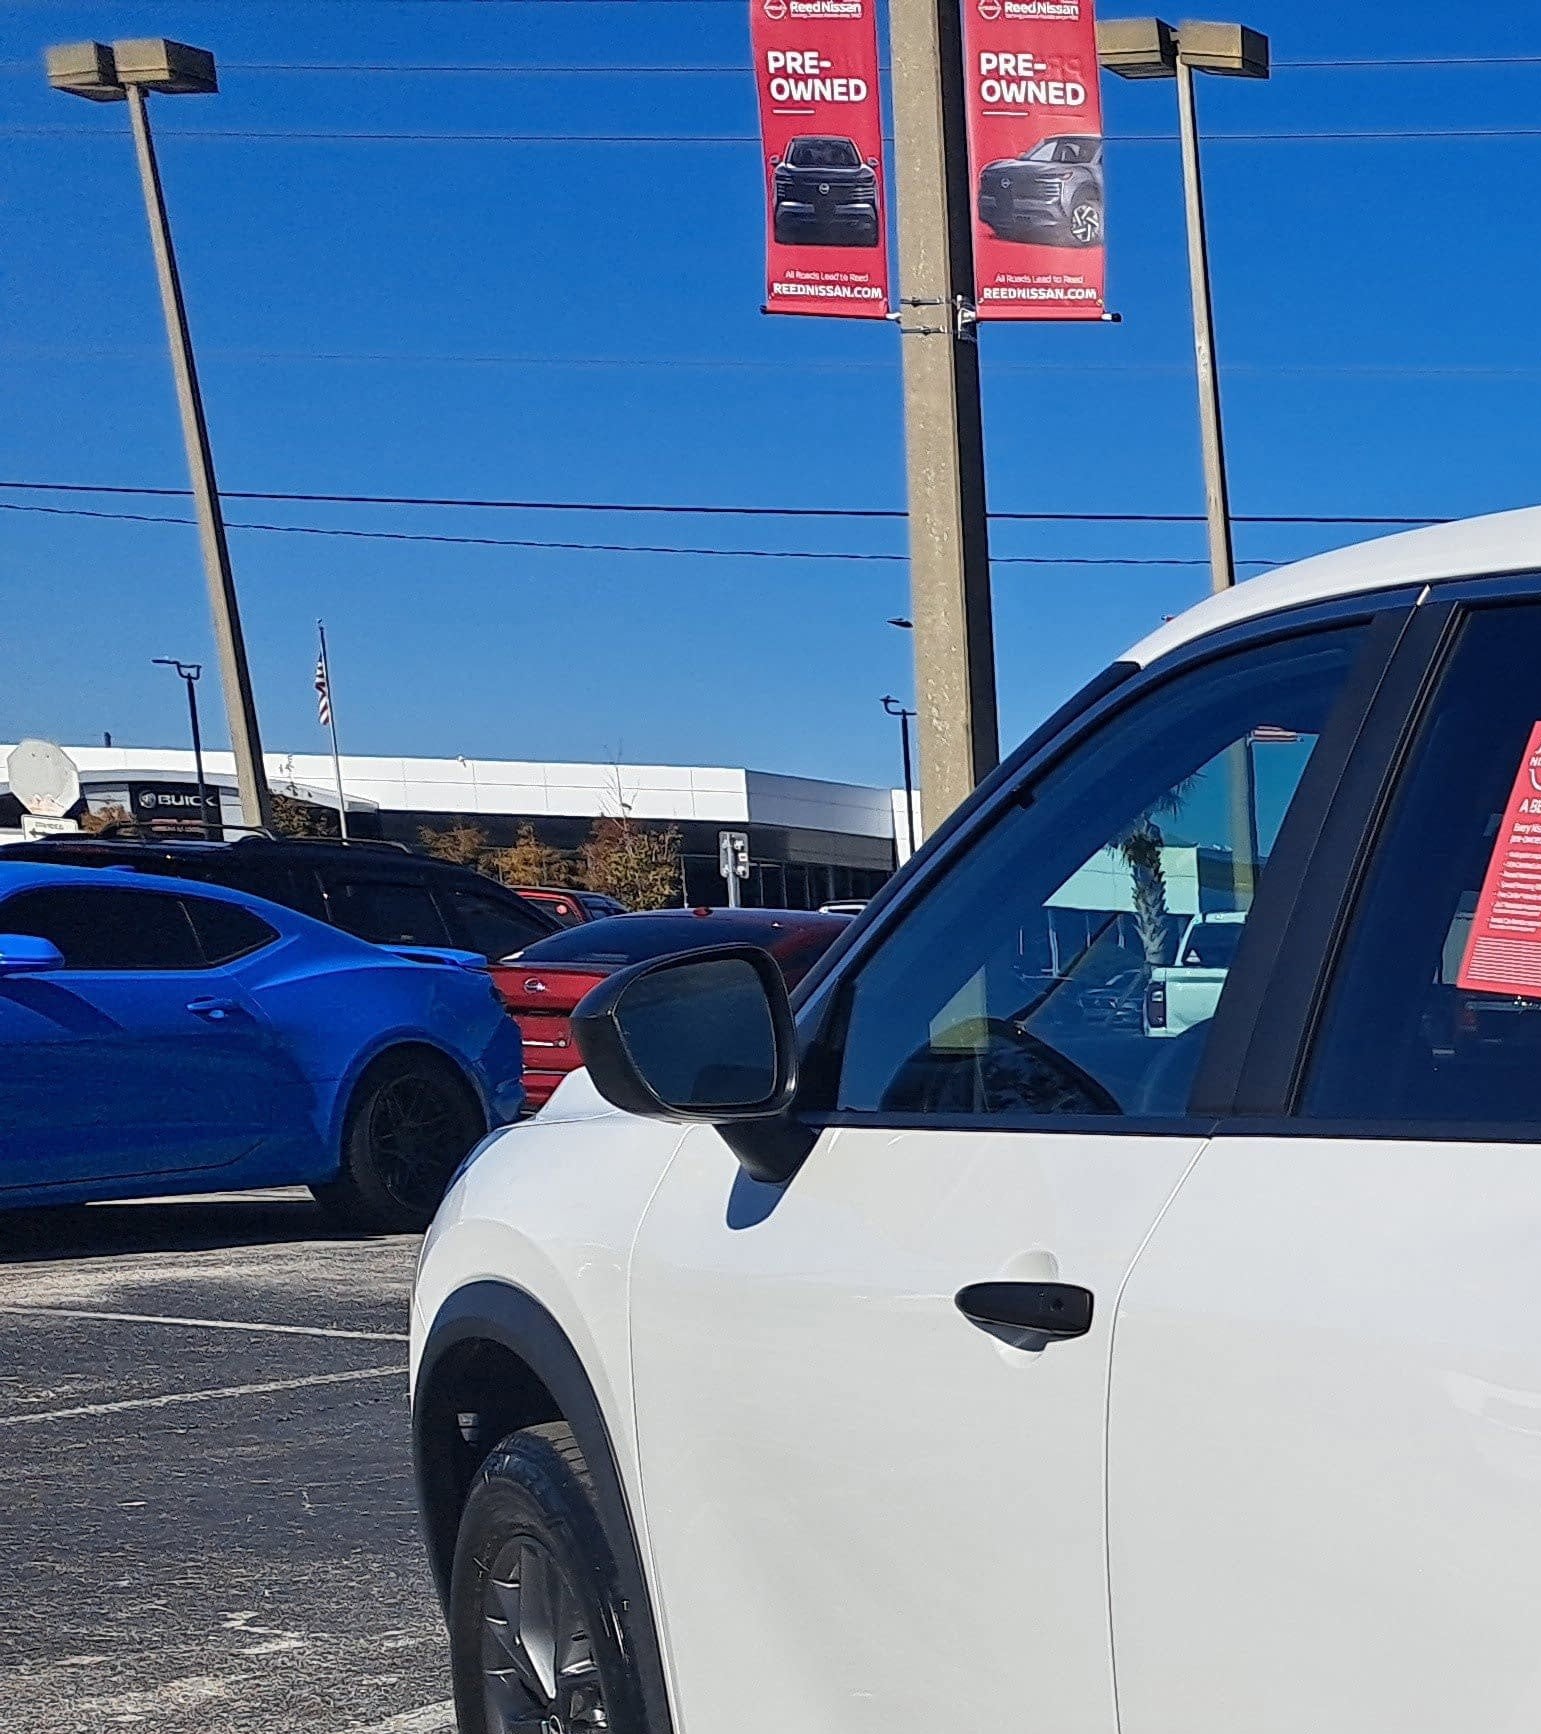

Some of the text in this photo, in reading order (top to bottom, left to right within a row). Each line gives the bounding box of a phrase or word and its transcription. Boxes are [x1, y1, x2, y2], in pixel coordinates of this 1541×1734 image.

[767, 51, 832, 75] PRE-
[980, 52, 1047, 76] PRE-
[770, 77, 868, 102] OWNED
[981, 79, 1086, 106] OWNED
[773, 282, 883, 299] REEDNISSAN.COM
[983, 287, 1097, 300] REEDNISSAN.COM
[158, 794, 218, 807] BUICK
[1519, 799, 1530, 814] A
